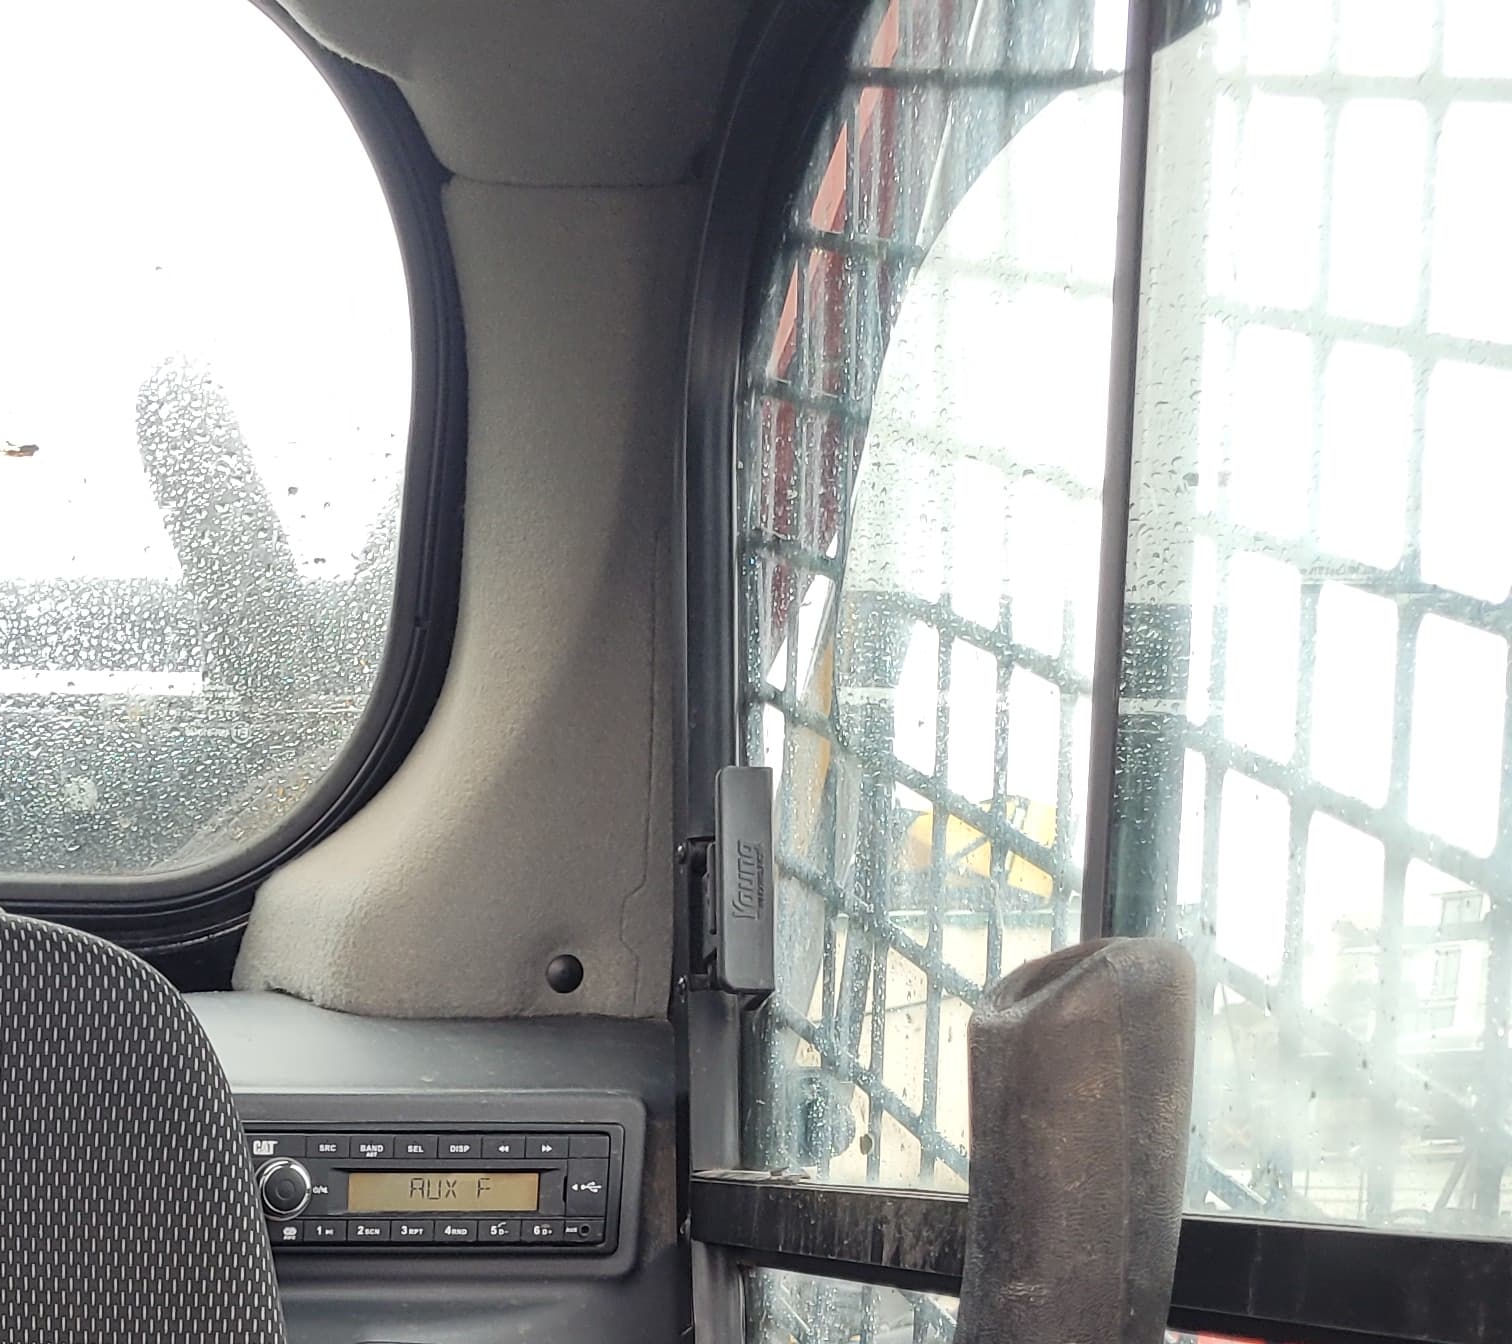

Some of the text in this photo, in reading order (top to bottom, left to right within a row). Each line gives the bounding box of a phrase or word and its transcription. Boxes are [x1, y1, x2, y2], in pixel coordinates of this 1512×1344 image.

[732, 839, 760, 920] Young
[253, 1140, 278, 1155] CAT
[319, 1144, 336, 1152] SRC
[360, 1144, 384, 1152] BAND
[408, 1145, 424, 1153] SEL
[450, 1145, 470, 1153] DISP
[410, 1177, 491, 1199] AUX F
[316, 1225, 322, 1235] 1
